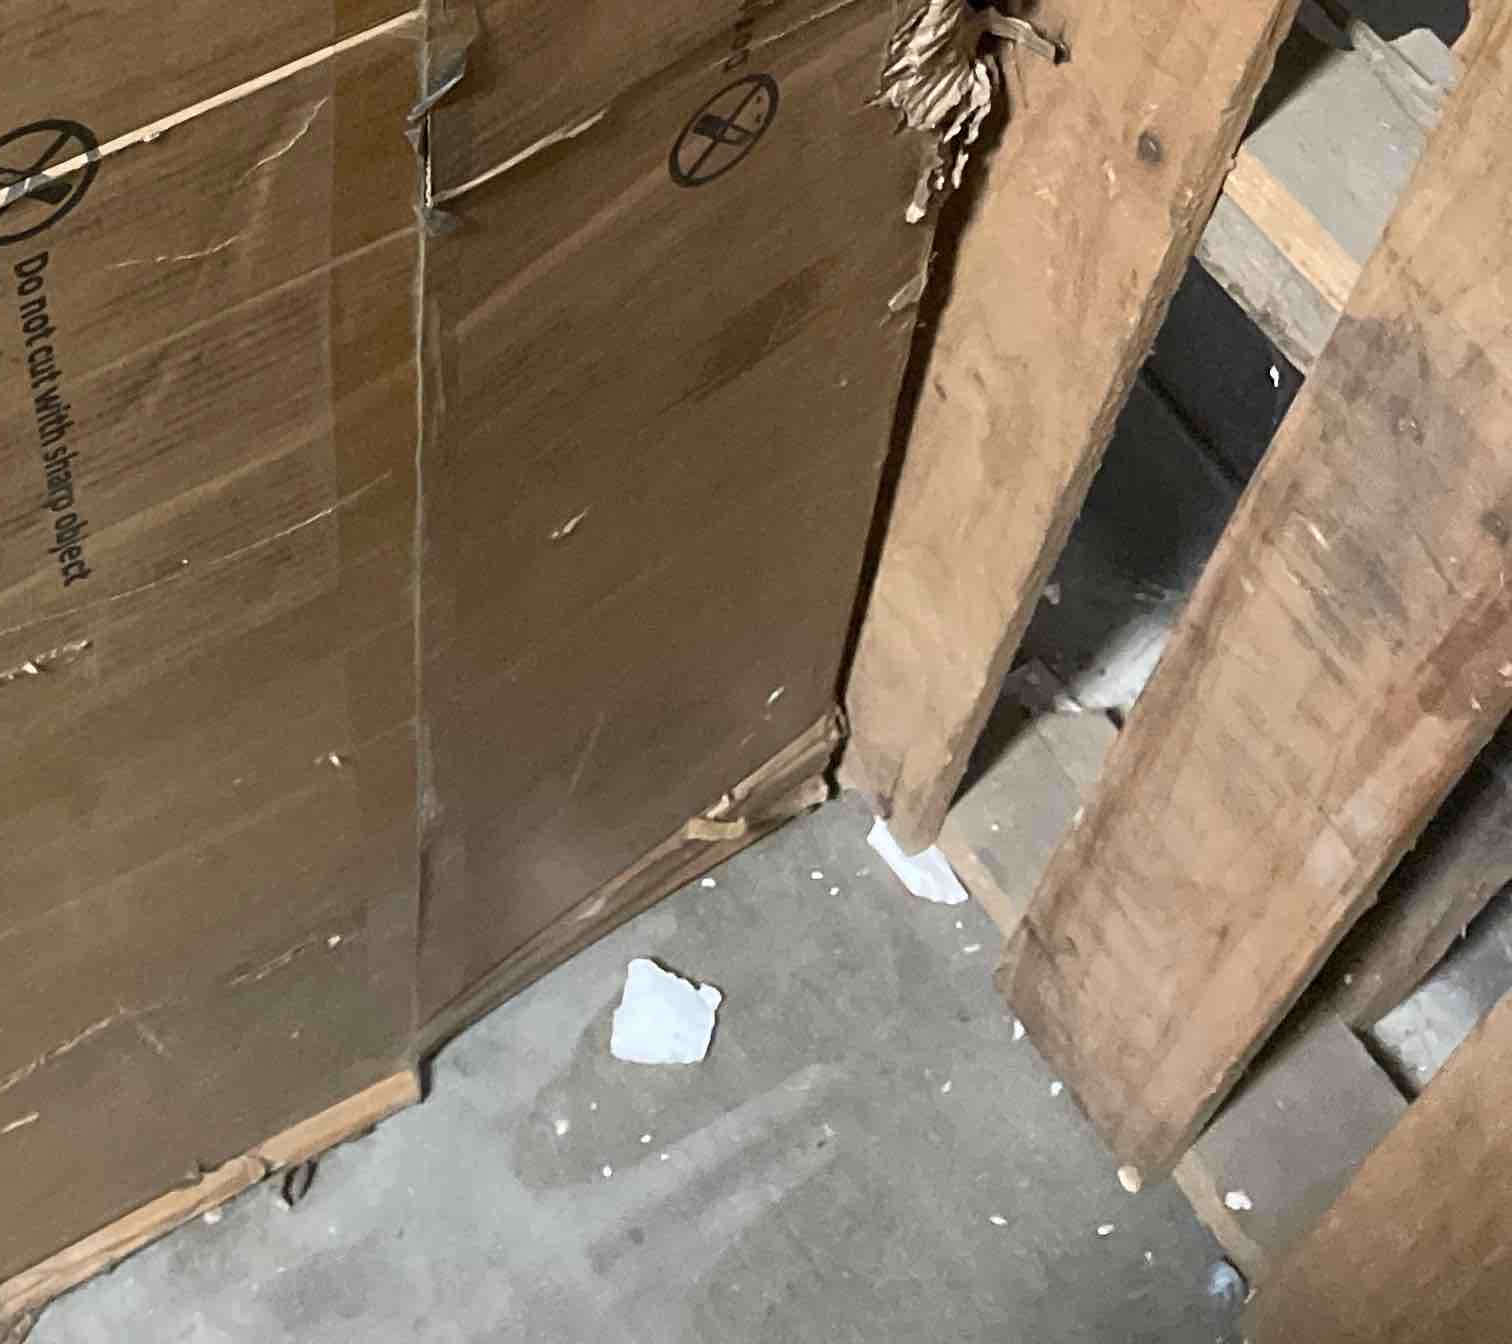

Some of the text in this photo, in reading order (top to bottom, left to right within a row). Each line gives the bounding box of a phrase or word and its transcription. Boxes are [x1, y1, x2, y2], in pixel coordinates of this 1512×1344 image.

[14, 251, 93, 588] Do not cut with sharp object
